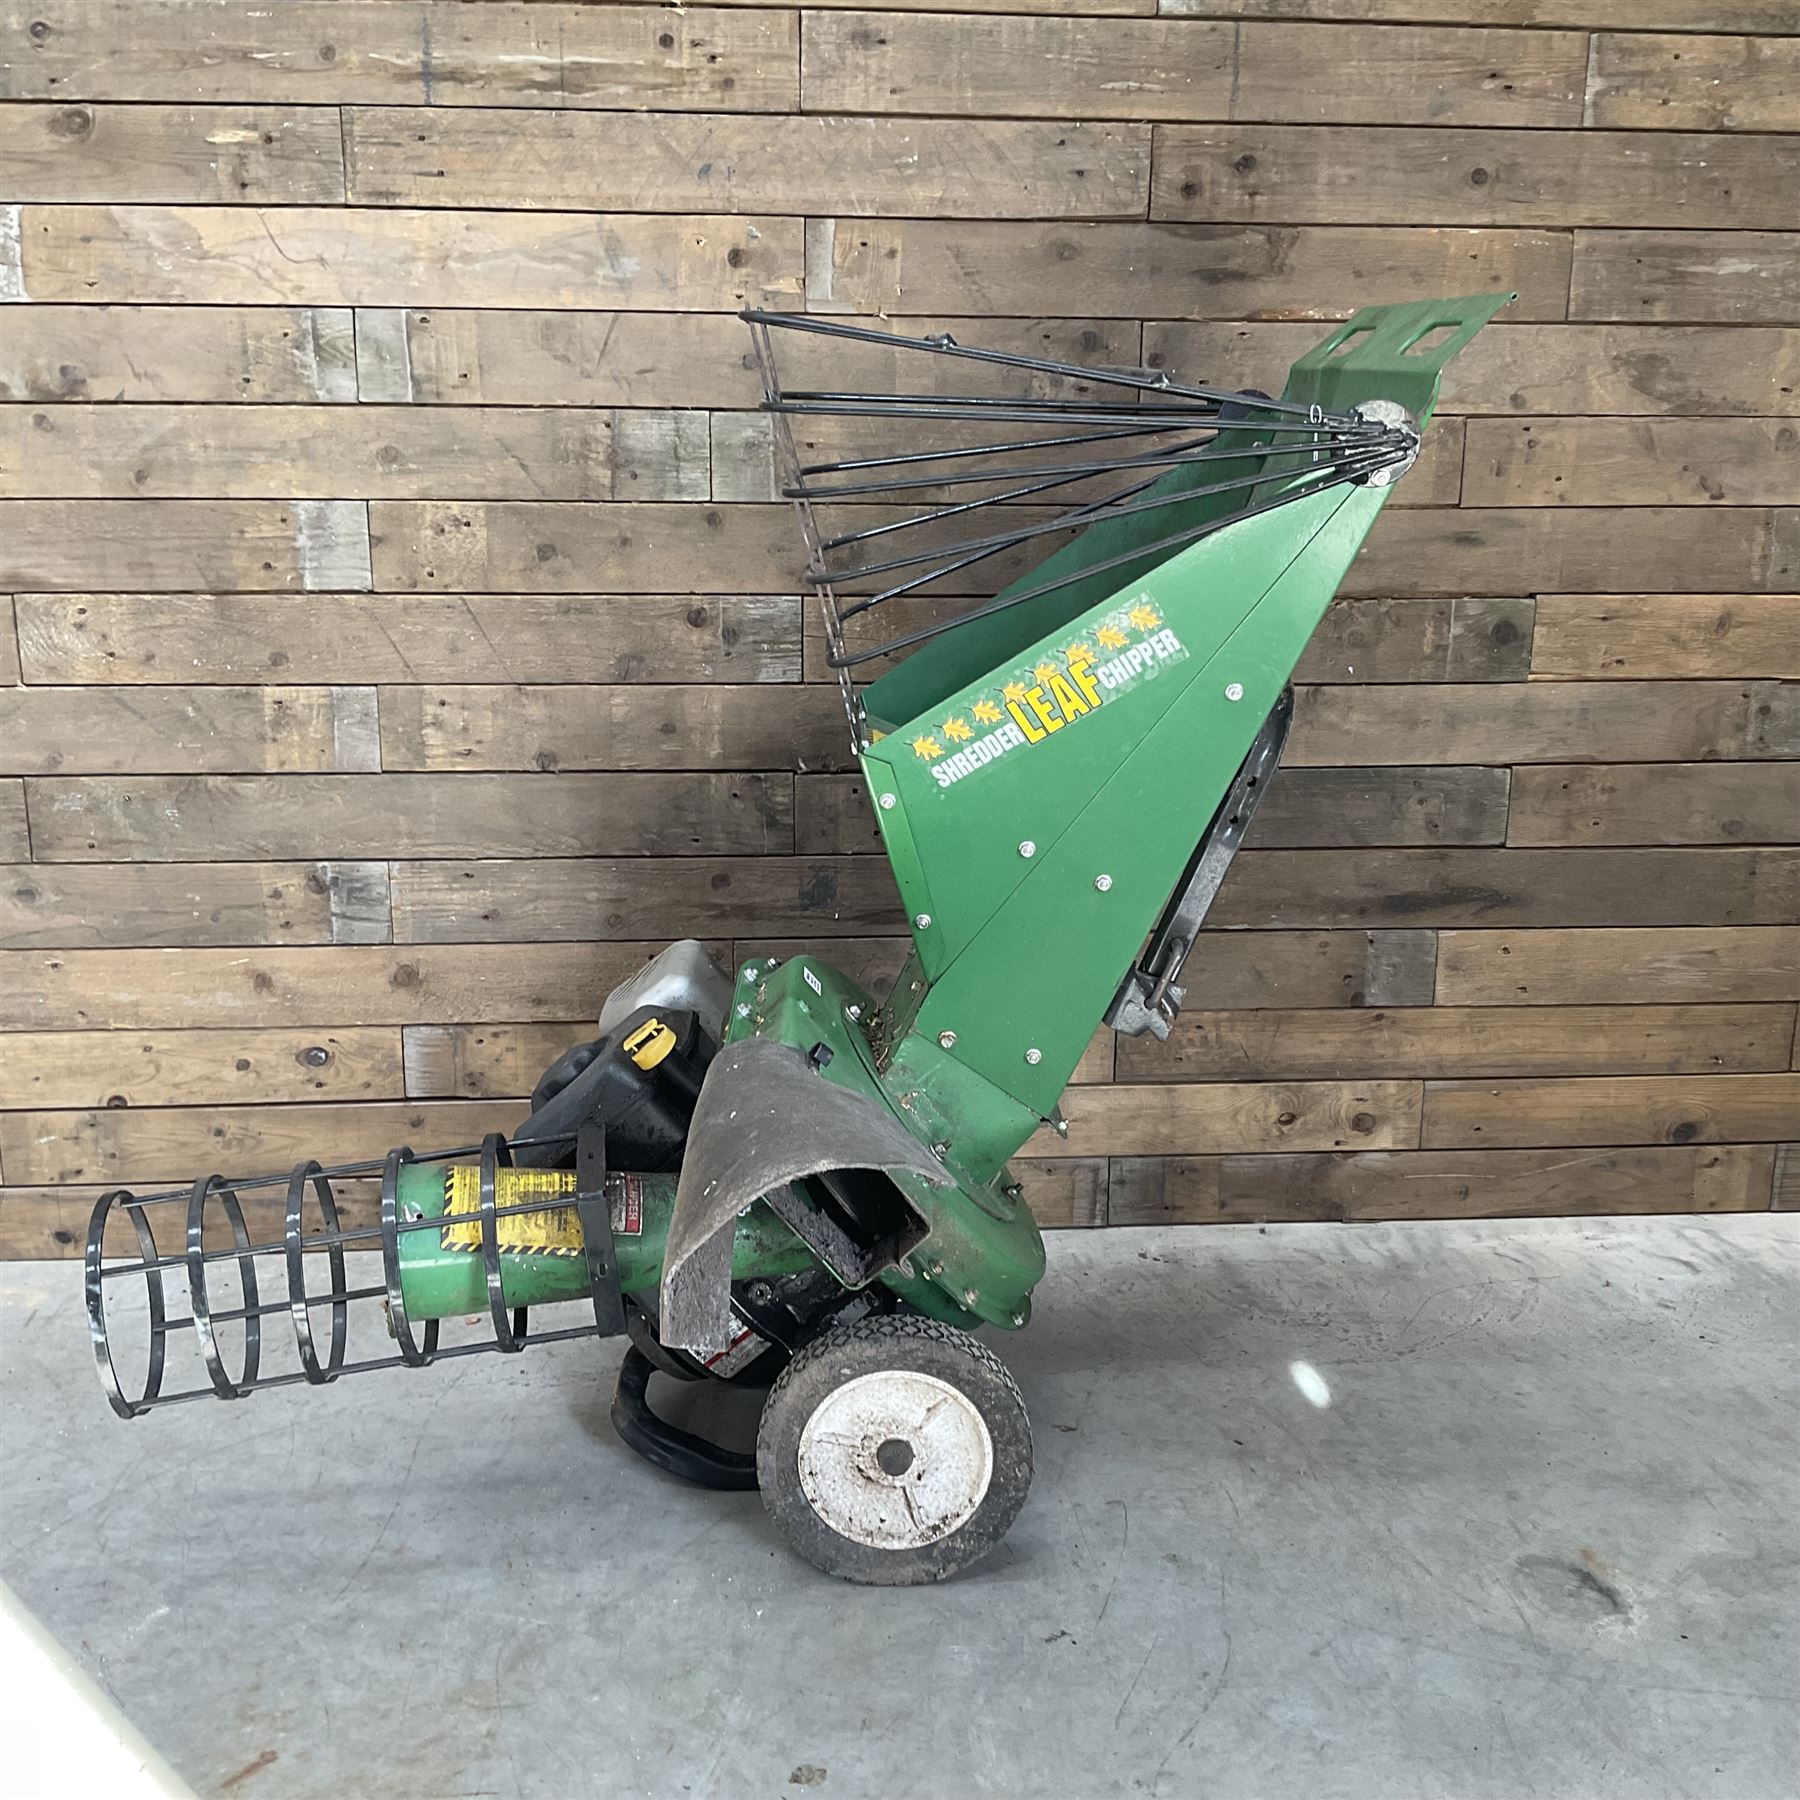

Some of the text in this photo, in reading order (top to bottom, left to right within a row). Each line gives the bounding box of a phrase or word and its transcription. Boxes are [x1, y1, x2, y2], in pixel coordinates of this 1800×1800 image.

[931, 628, 1181, 788] SHREDDER LEAF CHIPPER
